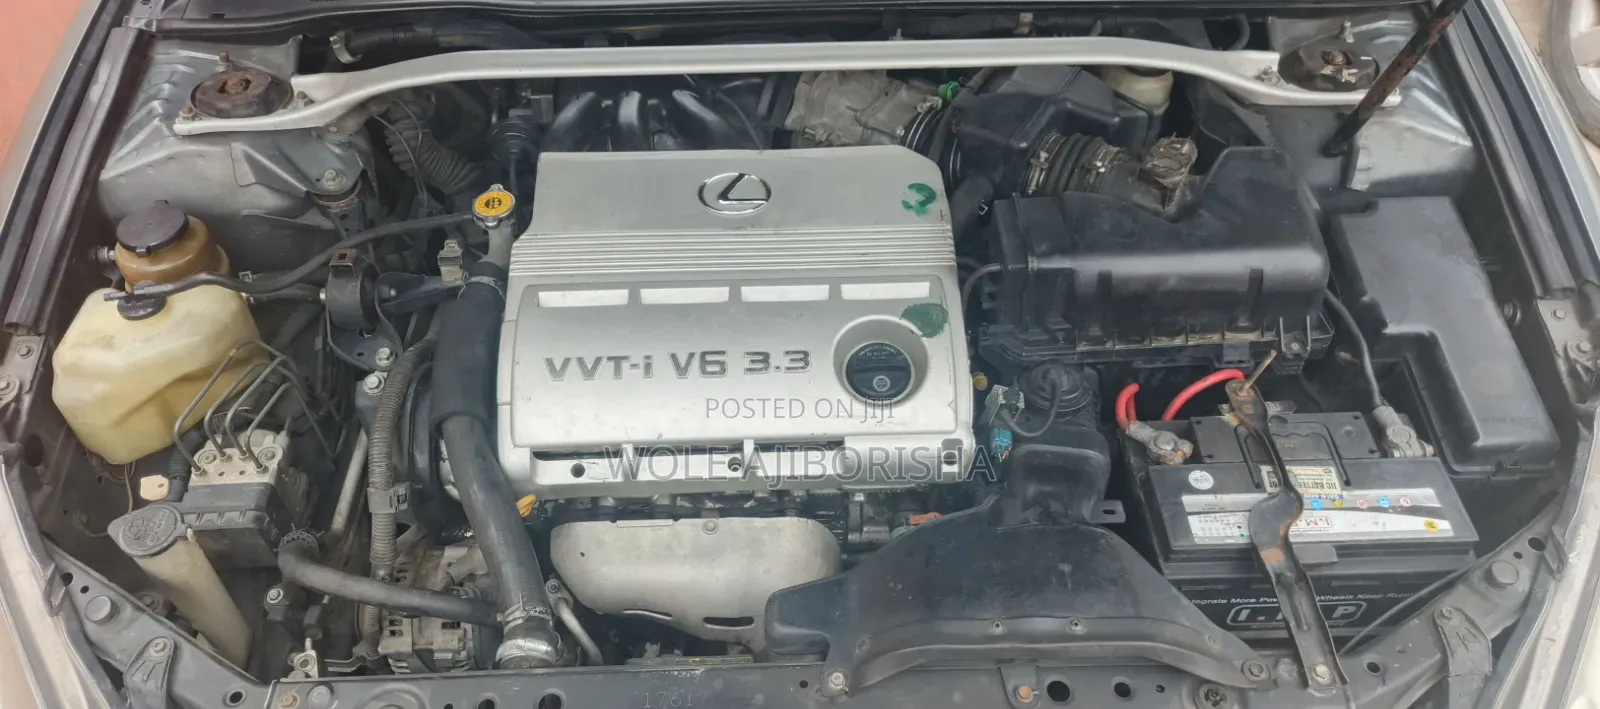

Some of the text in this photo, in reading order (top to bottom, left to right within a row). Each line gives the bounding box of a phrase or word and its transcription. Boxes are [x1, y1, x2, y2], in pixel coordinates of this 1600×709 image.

[544, 350, 812, 381] VVT-i V6 3.3
